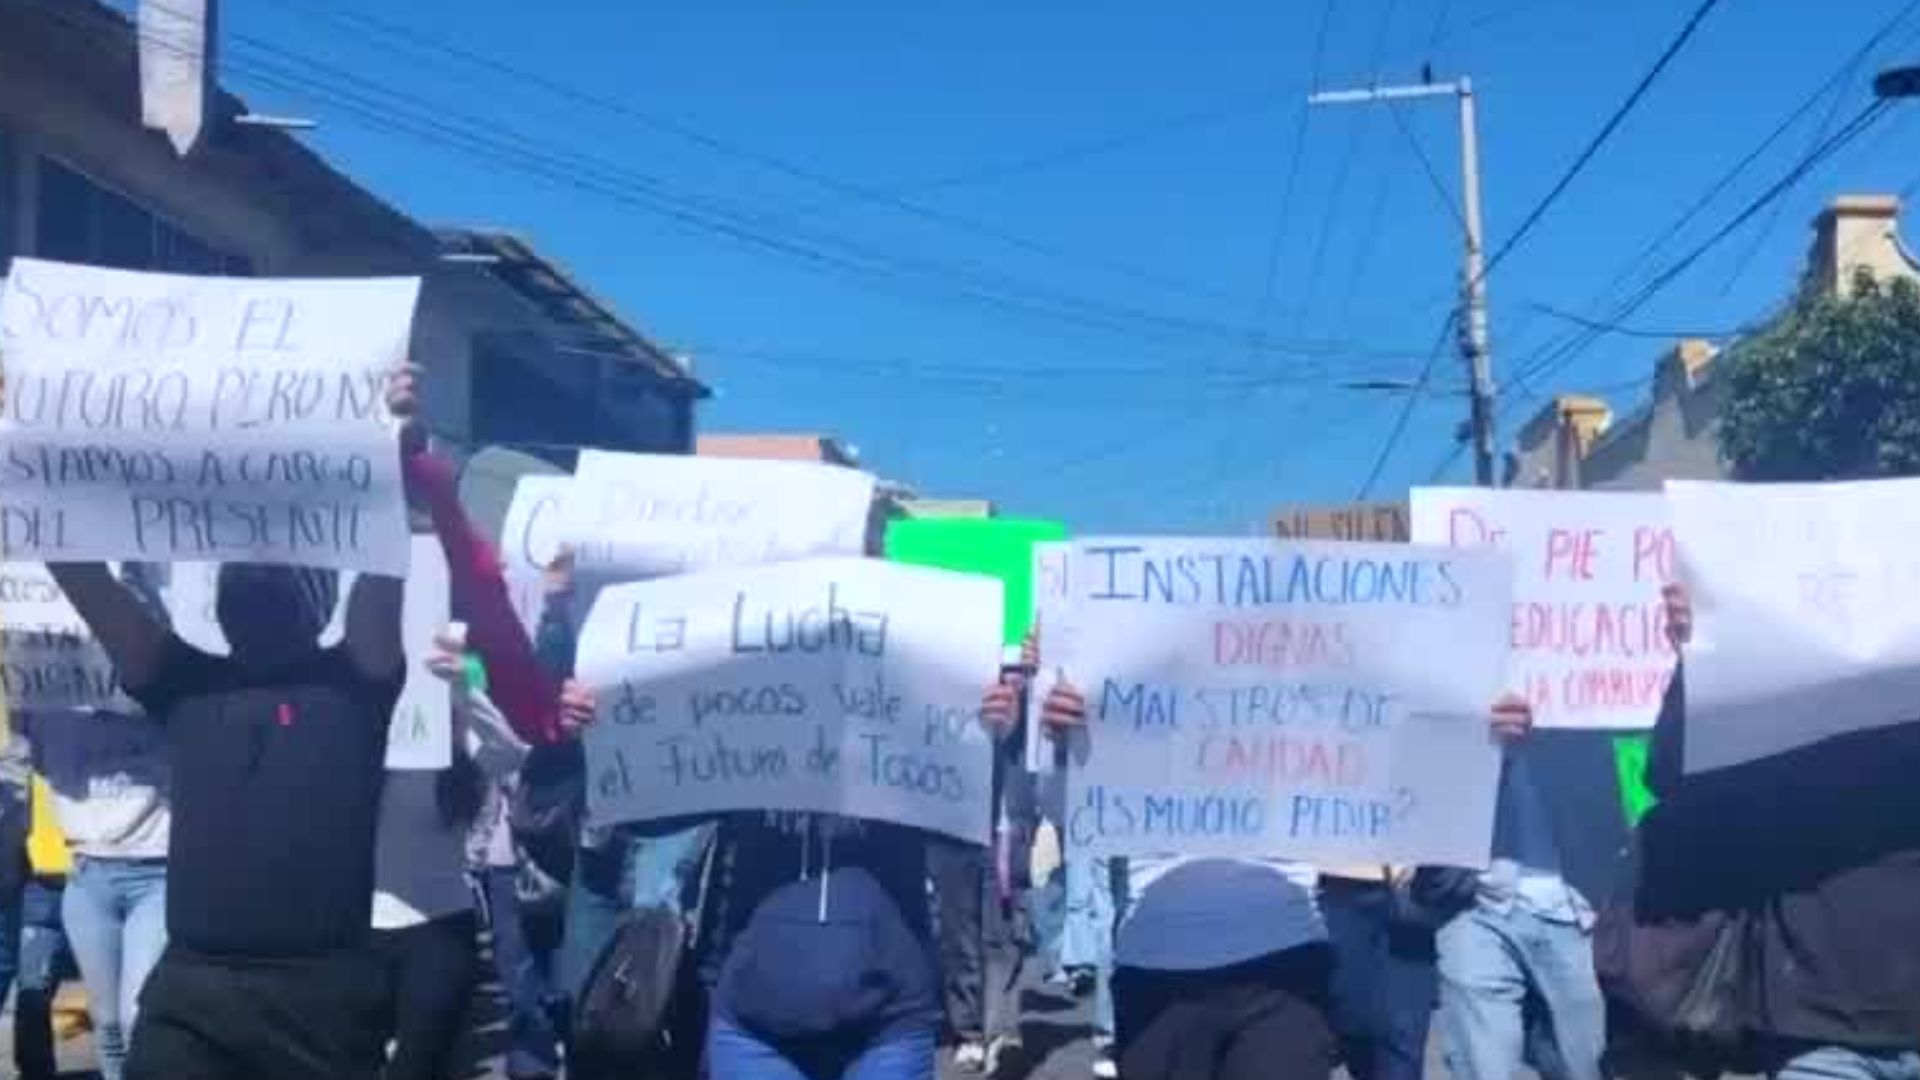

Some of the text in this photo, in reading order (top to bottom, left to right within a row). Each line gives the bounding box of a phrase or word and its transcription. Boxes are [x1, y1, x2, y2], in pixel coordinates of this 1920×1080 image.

[236, 297, 302, 353] EL
[13, 366, 191, 431] UTURO
[211, 366, 325, 431] PERO
[7, 444, 374, 491] STAMOS A CARGO
[1329, 504, 1410, 542] SILEN
[1449, 507, 1677, 582] D PIE PO
[1086, 545, 1463, 603] INSTALACIONES
[627, 581, 890, 658] La Lucha
[1214, 620, 1353, 667] DIGNAS
[1510, 600, 1668, 658] EDUCACIO
[612, 679, 657, 726] de
[689, 683, 806, 724] pocos
[1099, 677, 1326, 730] MAESTROS
[600, 750, 633, 799] el
